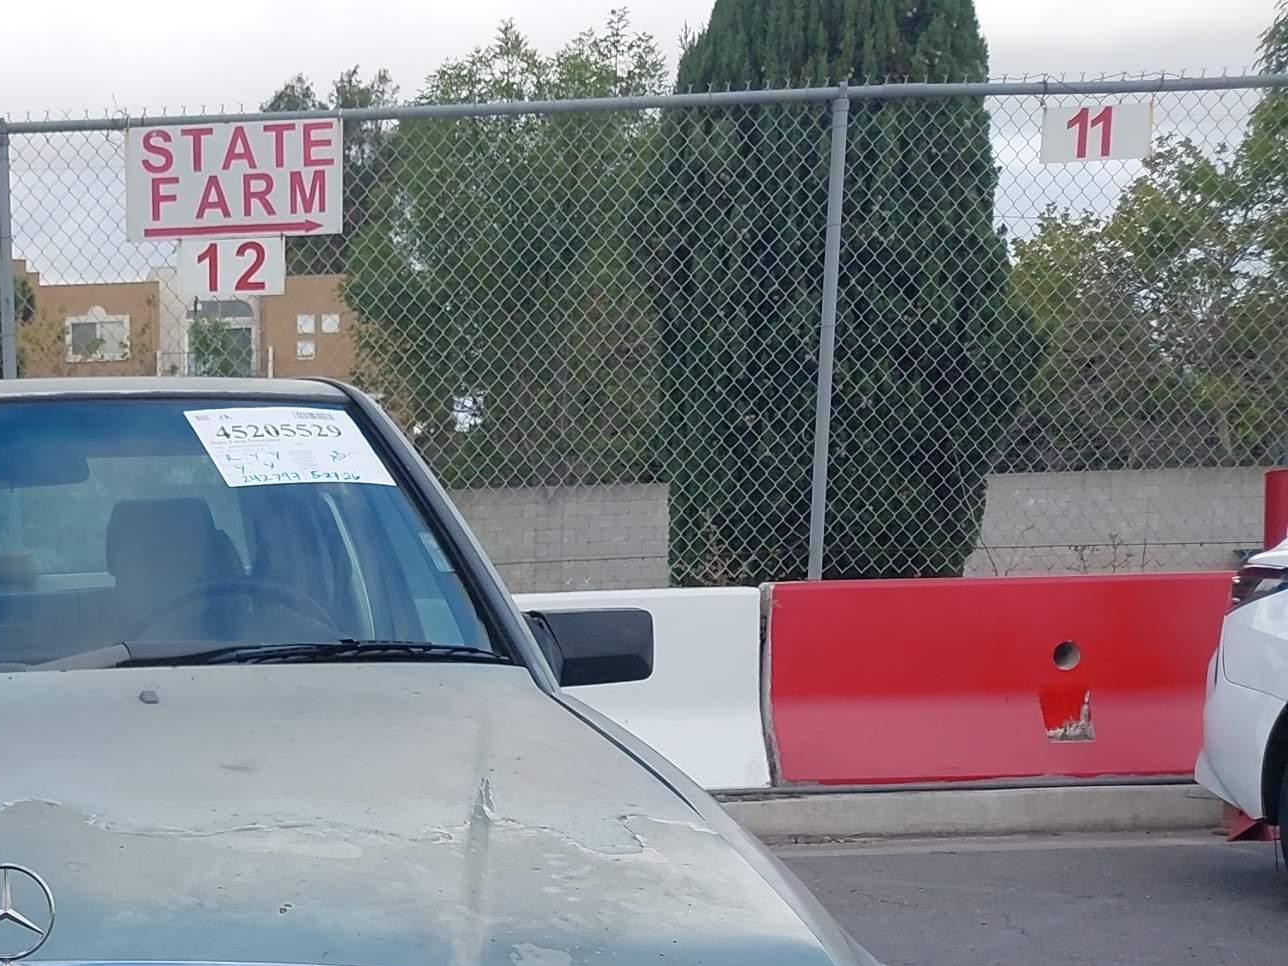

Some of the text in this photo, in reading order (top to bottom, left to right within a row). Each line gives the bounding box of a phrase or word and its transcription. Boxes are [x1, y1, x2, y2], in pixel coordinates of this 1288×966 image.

[141, 122, 335, 173] STATE
[1066, 106, 1113, 158] 11
[151, 169, 327, 221] FARM
[196, 241, 266, 292] 12
[216, 424, 342, 439] 45205529
